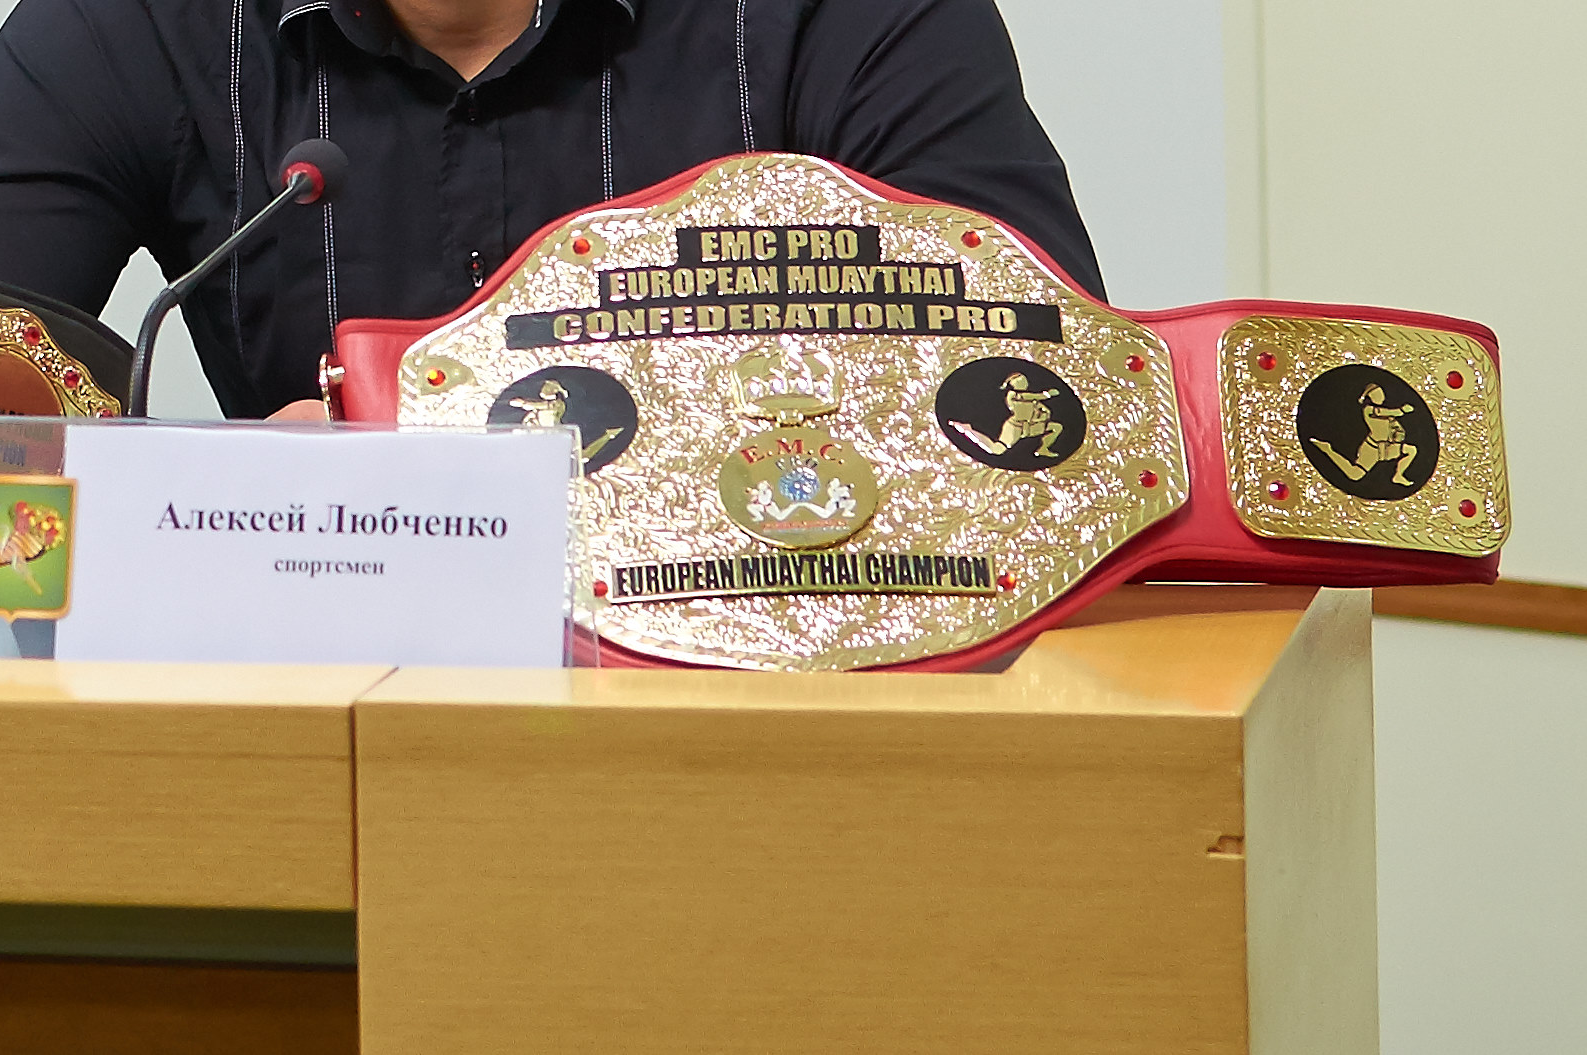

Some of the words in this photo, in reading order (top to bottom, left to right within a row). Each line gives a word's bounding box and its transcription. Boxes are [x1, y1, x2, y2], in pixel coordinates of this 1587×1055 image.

[701, 231, 776, 263] EMC
[787, 228, 860, 260] PRO
[608, 266, 779, 302] EUROPEAN
[786, 264, 956, 296] MUAYTHAI
[552, 302, 915, 342] CONFEDERATION
[926, 304, 1018, 333] PRO
[157, 502, 306, 534] Алексей
[318, 504, 509, 539] Любченко
[274, 557, 385, 578] спортсмен
[616, 558, 735, 597] EUROPEAN
[740, 554, 859, 588] MUAYTHAI
[865, 553, 991, 589] CHAMPION
